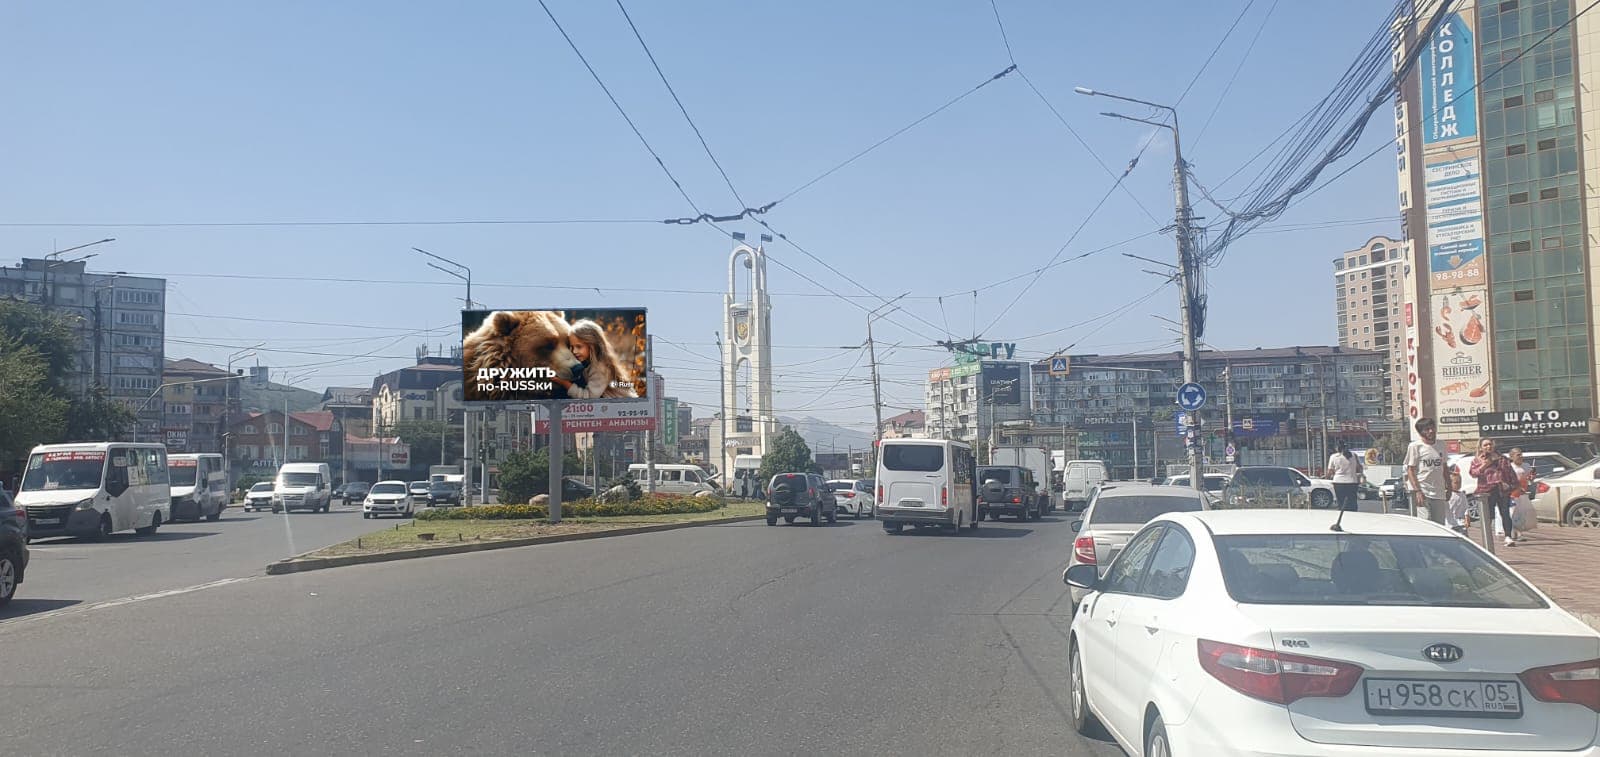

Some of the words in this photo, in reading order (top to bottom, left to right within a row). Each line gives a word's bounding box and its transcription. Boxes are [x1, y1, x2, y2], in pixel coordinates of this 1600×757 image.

[1438, 22, 1459, 137] КОЛЛЕДЖ
[1399, 191, 1411, 279] ЦЕНТР
[1435, 268, 1480, 281] 98-98-88
[476, 367, 557, 381] ДРУЖИТЬ
[477, 380, 553, 392] по-RUSSки
[565, 403, 594, 414] 21:00
[617, 409, 649, 418] 92-95-95
[1441, 407, 1466, 415] СУШИ
[1084, 416, 1115, 425] DENTAL
[1504, 410, 1560, 422] ШАТО
[566, 419, 602, 429] РЕНТГЕН
[608, 418, 649, 428] АНАЛИЗЫ
[166, 431, 187, 439] ОКНА
[1429, 646, 1459, 659] KIA
[1484, 684, 1509, 701] 05
[1484, 702, 1503, 710] RUS
